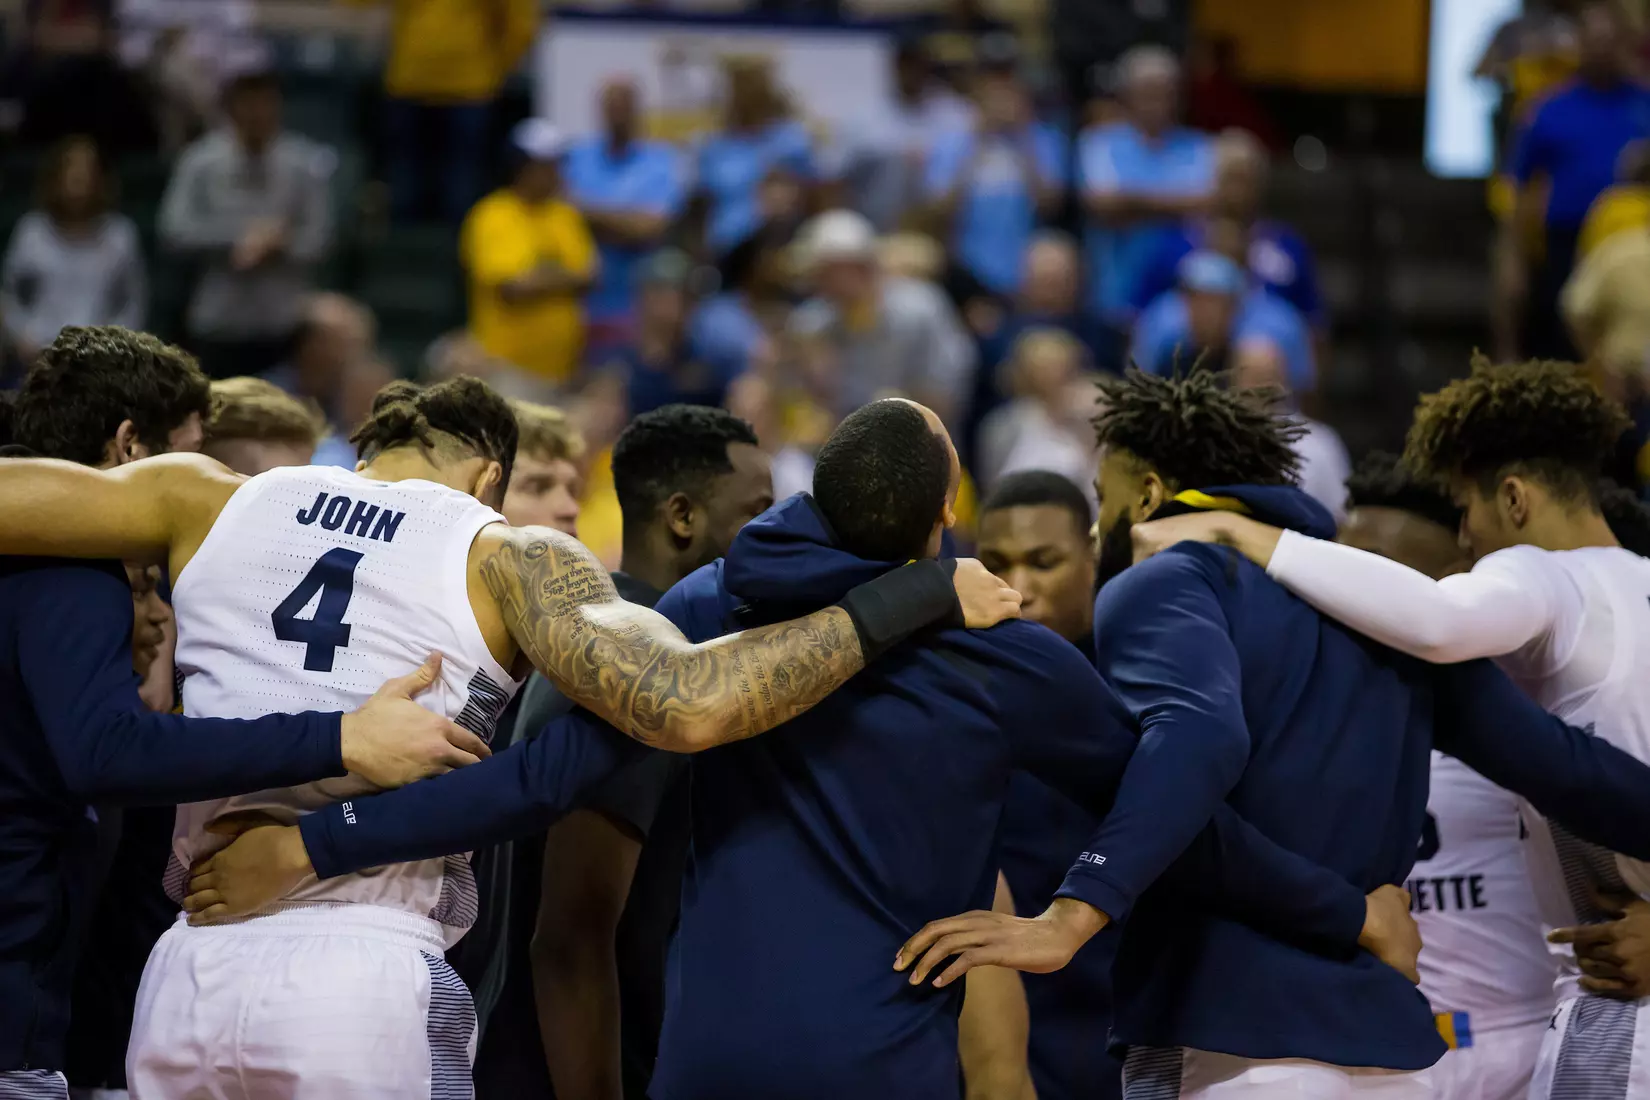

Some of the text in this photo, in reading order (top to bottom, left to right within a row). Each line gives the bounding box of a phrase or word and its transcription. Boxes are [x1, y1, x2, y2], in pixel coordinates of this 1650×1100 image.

[296, 492, 406, 543] JOHN
[271, 547, 365, 673] 4
[1408, 874, 1488, 912] ETTE
